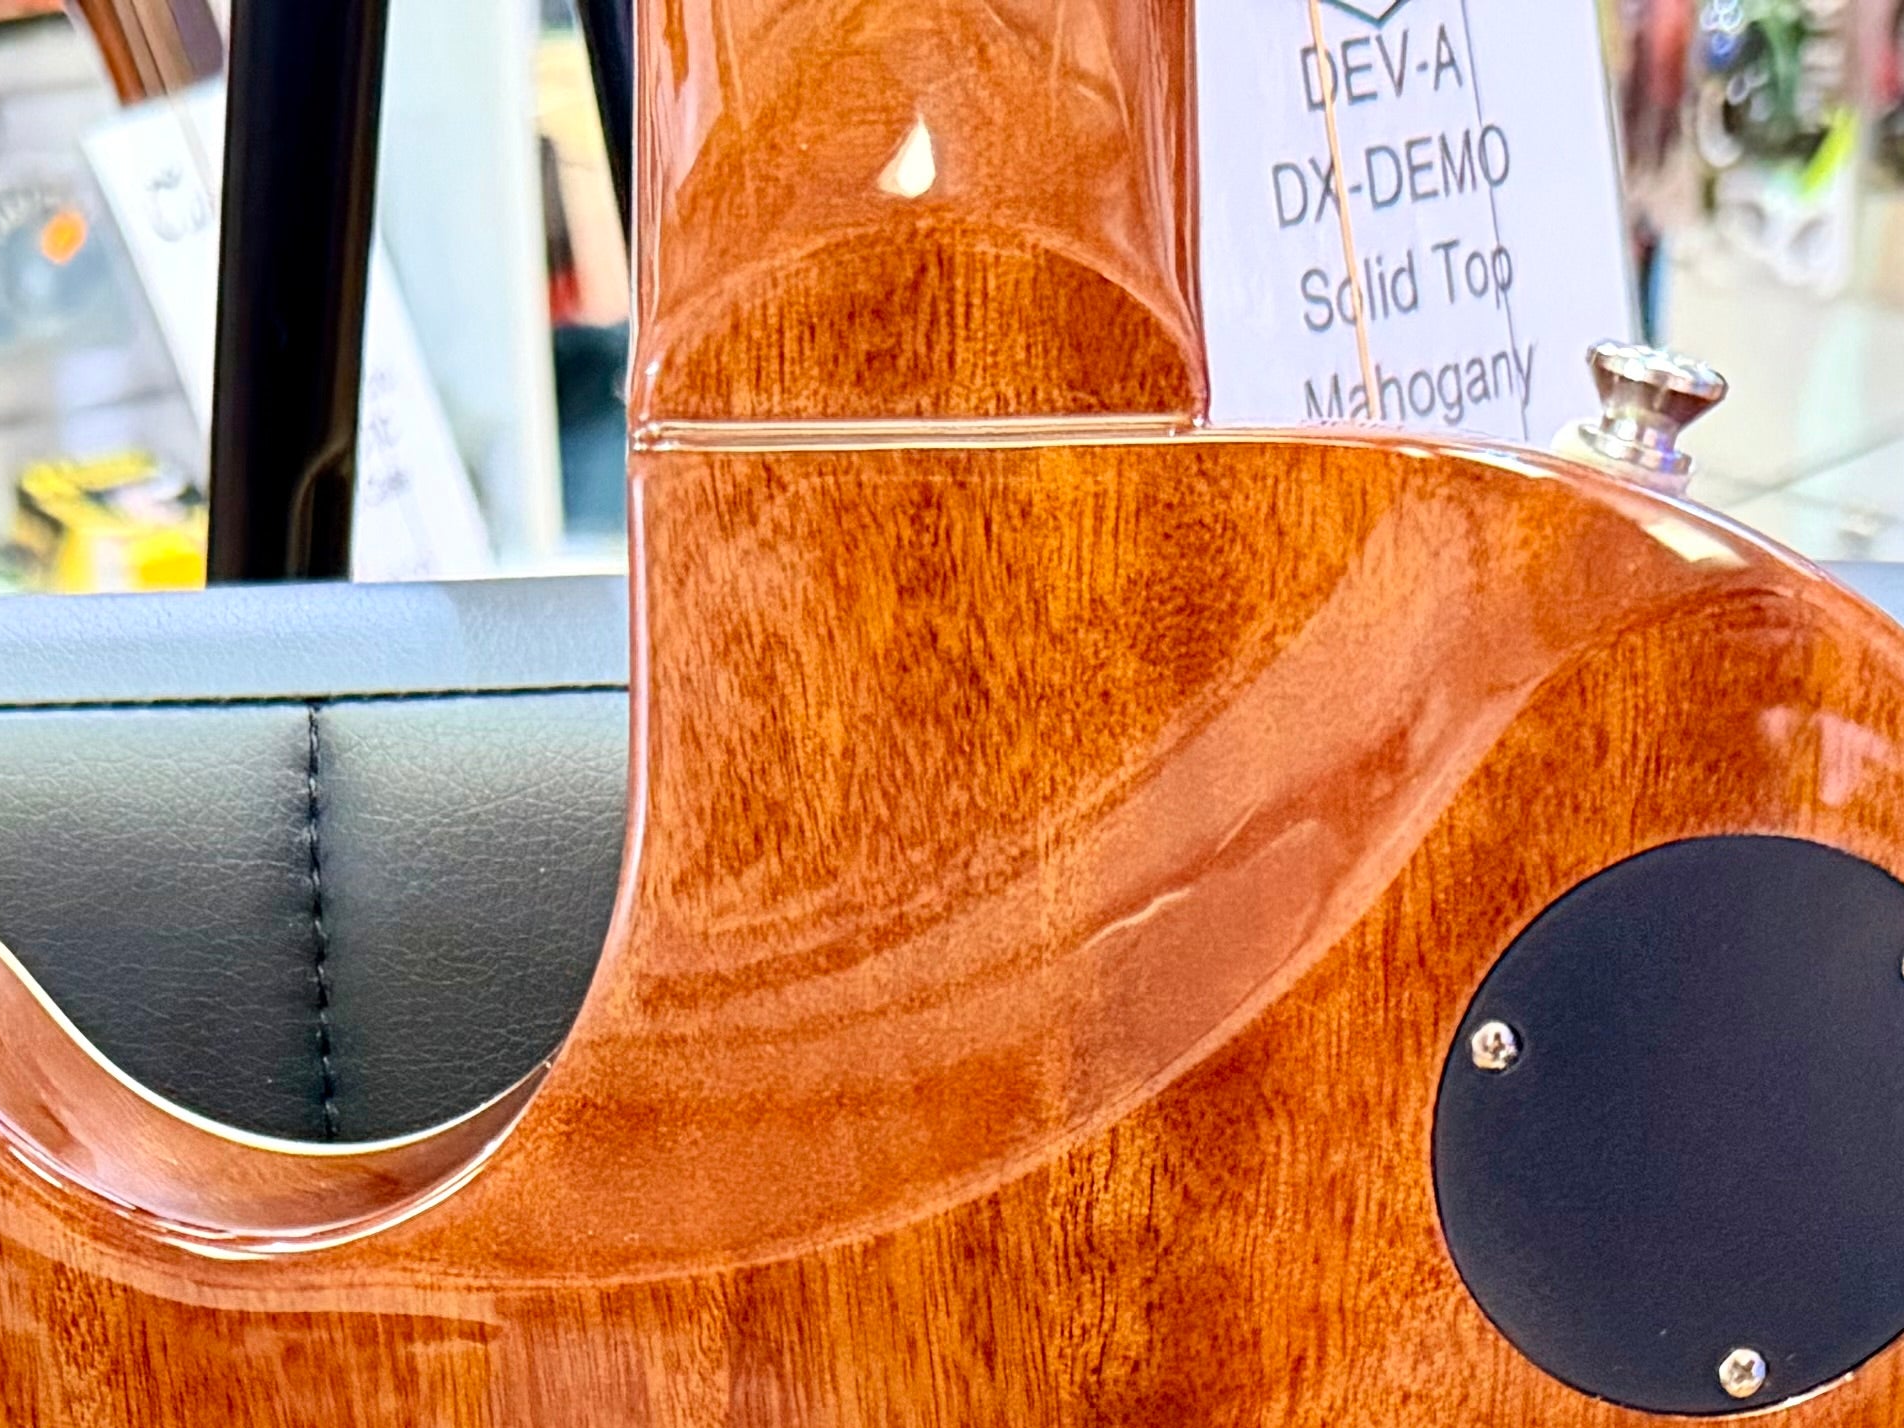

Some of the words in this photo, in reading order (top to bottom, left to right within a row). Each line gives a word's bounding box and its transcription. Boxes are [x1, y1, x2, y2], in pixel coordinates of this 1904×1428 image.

[1300, 24, 1462, 111] DEV-A
[1272, 124, 1509, 228] DX-DEMO
[1301, 249, 1418, 332] Solid
[1432, 239, 1513, 310] Top
[1305, 343, 1534, 424] Mahogany
